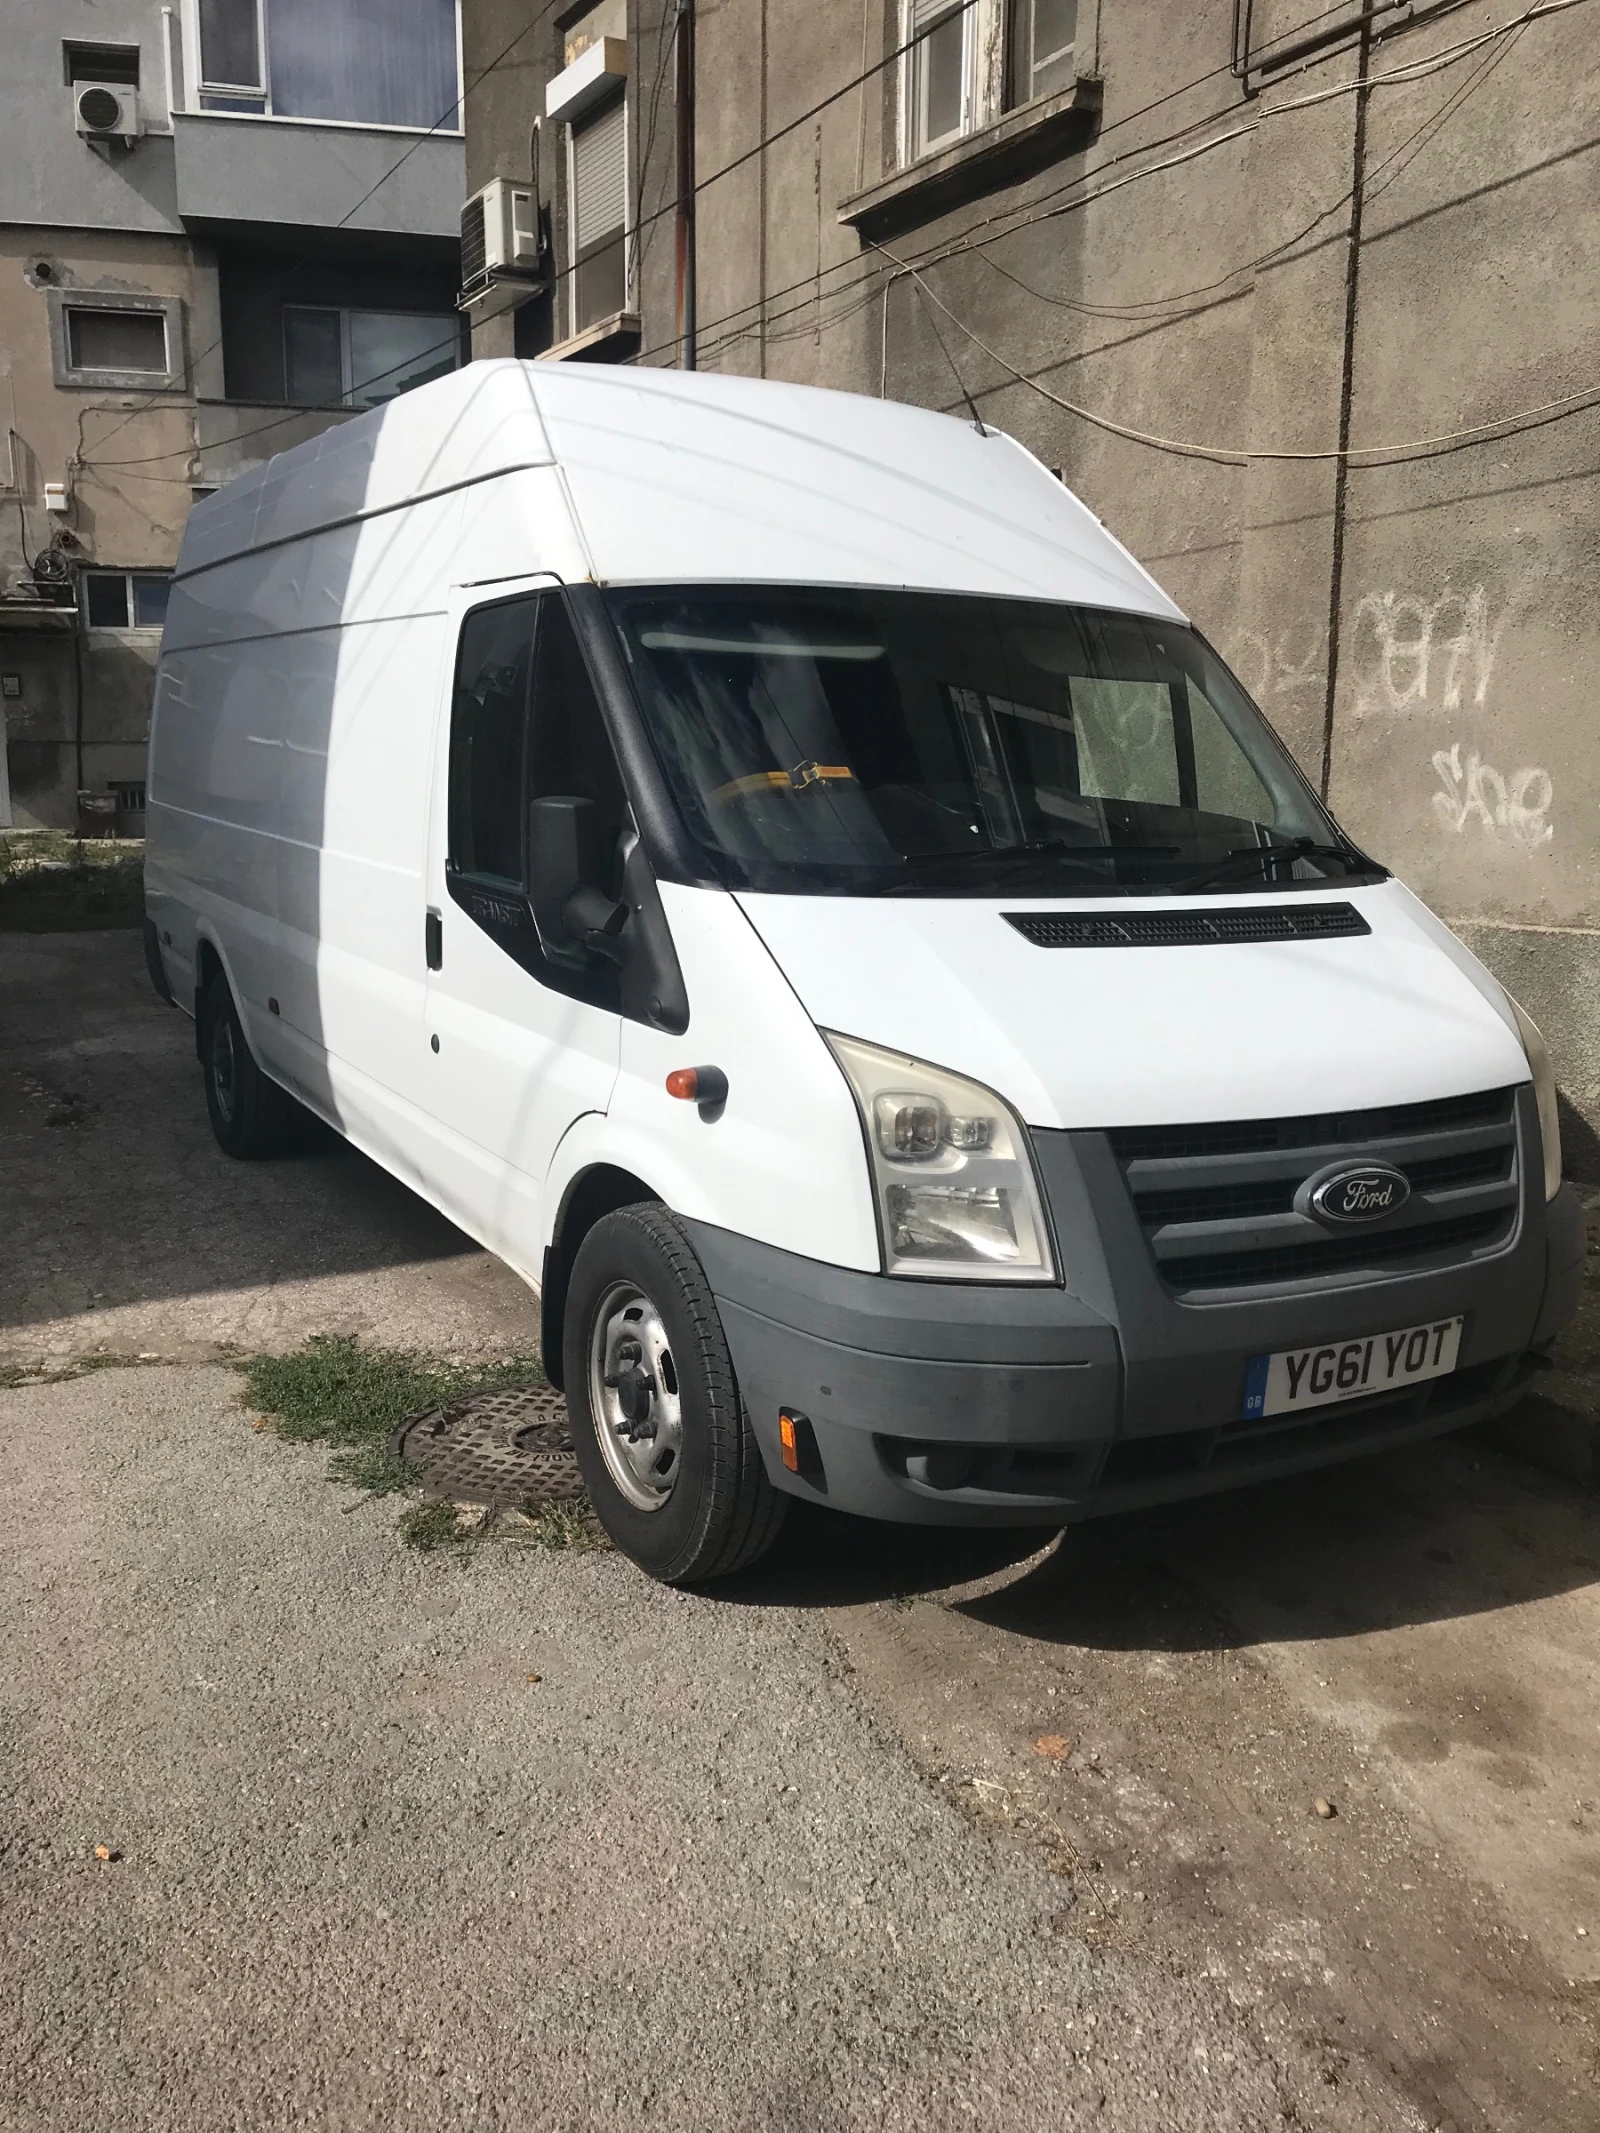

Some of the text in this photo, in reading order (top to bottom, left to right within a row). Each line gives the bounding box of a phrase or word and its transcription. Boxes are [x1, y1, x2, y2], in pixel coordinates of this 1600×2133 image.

[472, 895, 521, 926] TRANSIT
[1342, 1178, 1393, 1212] Ford
[1286, 1322, 1452, 1400] YG61 YOT
[1247, 1395, 1262, 1409] GB
